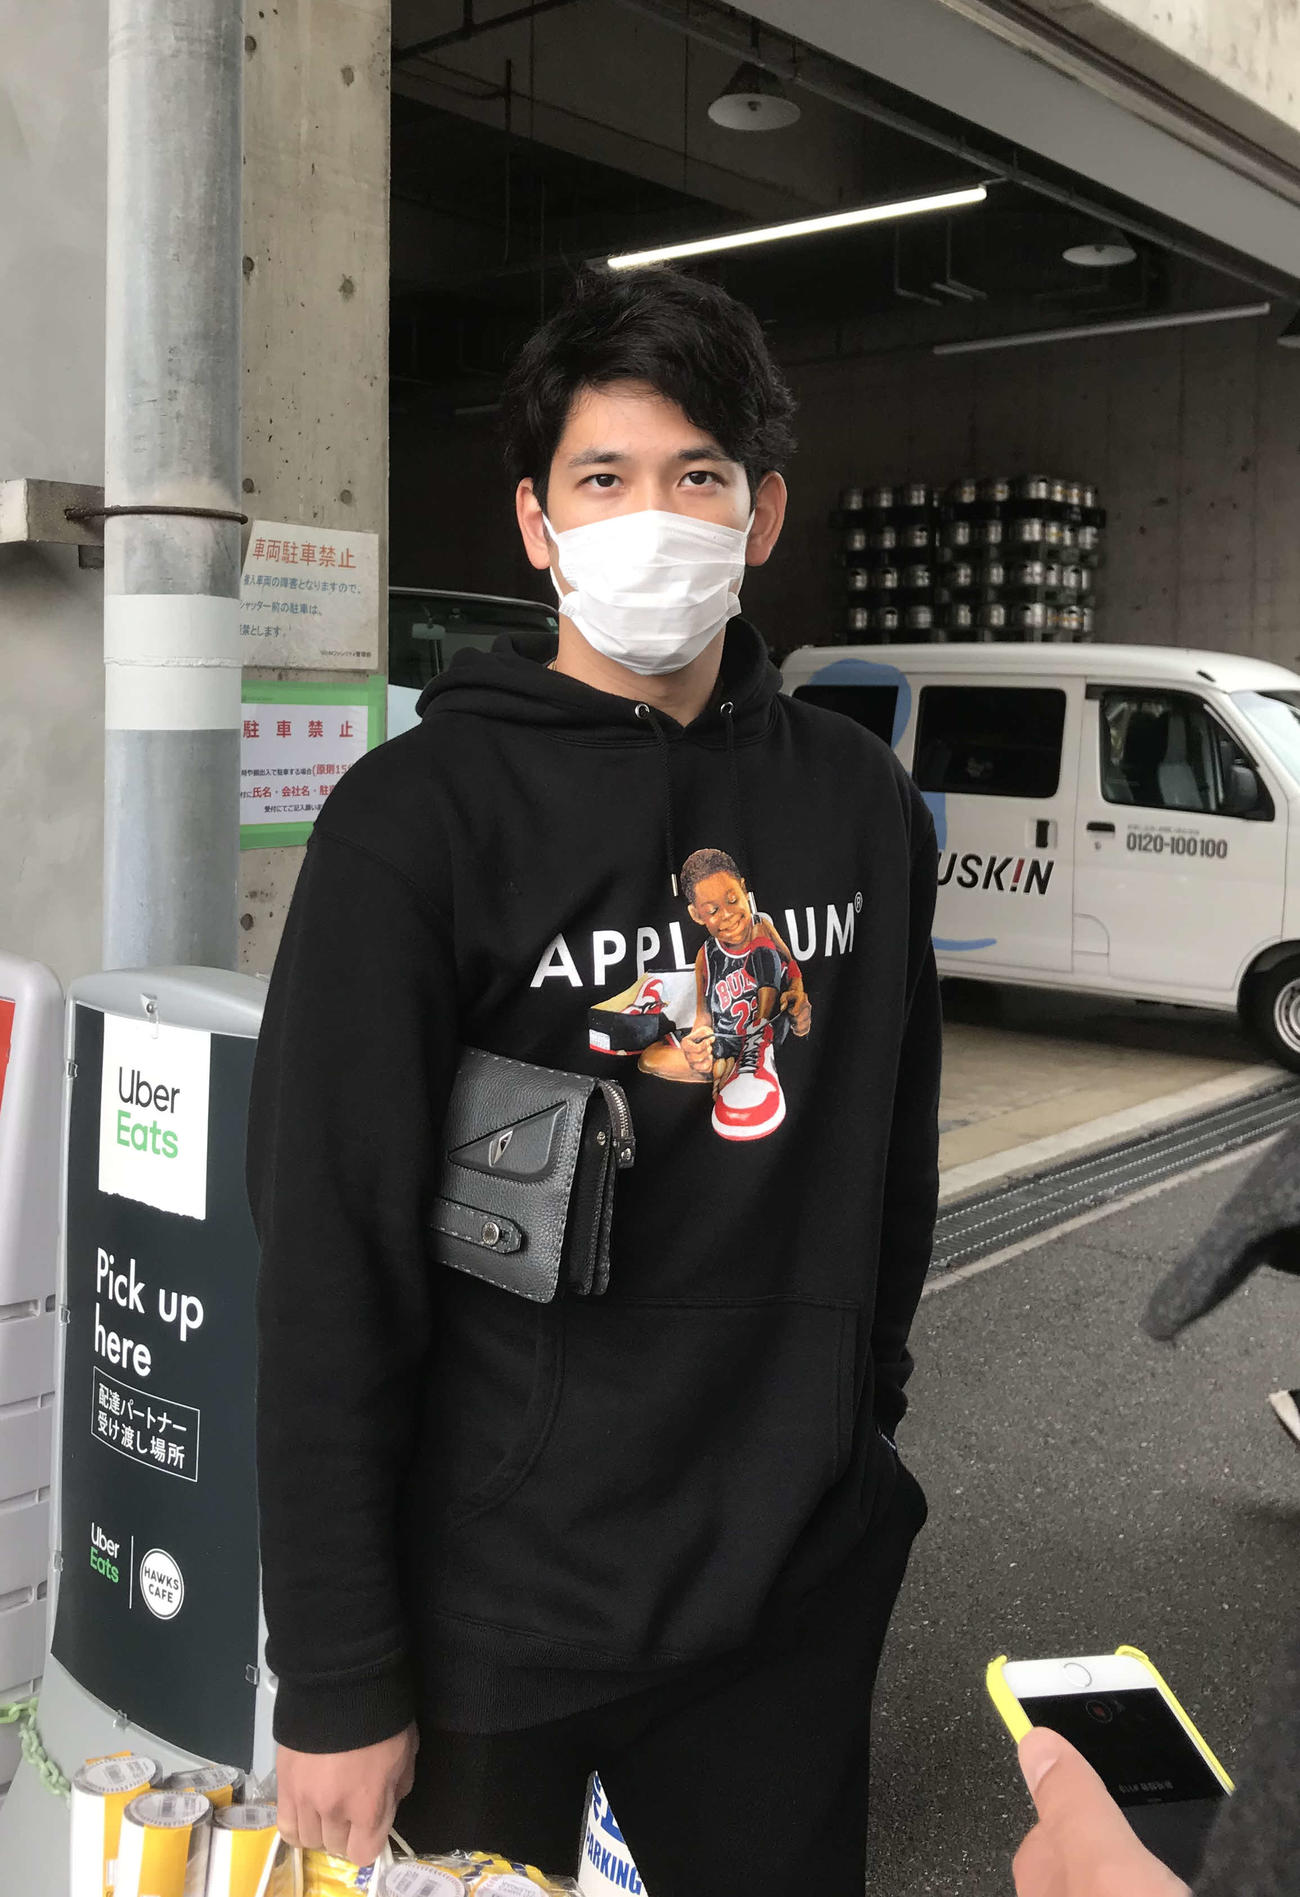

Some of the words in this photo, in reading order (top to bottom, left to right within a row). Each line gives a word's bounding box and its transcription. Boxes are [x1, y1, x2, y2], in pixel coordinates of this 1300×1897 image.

[252, 536, 357, 569] 車両駐車禁止
[529, 903, 857, 989] APPLUM
[118, 1066, 180, 1114] Uber
[116, 1109, 178, 1159] Eats
[96, 1247, 146, 1314] Pick
[158, 1288, 204, 1342] up
[94, 1302, 152, 1377] here
[98, 1383, 187, 1433] 配達パートナー
[97, 1410, 185, 1469] 受け渡し場所
[90, 1546, 119, 1583] Eats
[91, 1522, 120, 1558] Uber
[144, 1566, 179, 1591] HAWKS
[148, 1583, 174, 1603] CAFE
